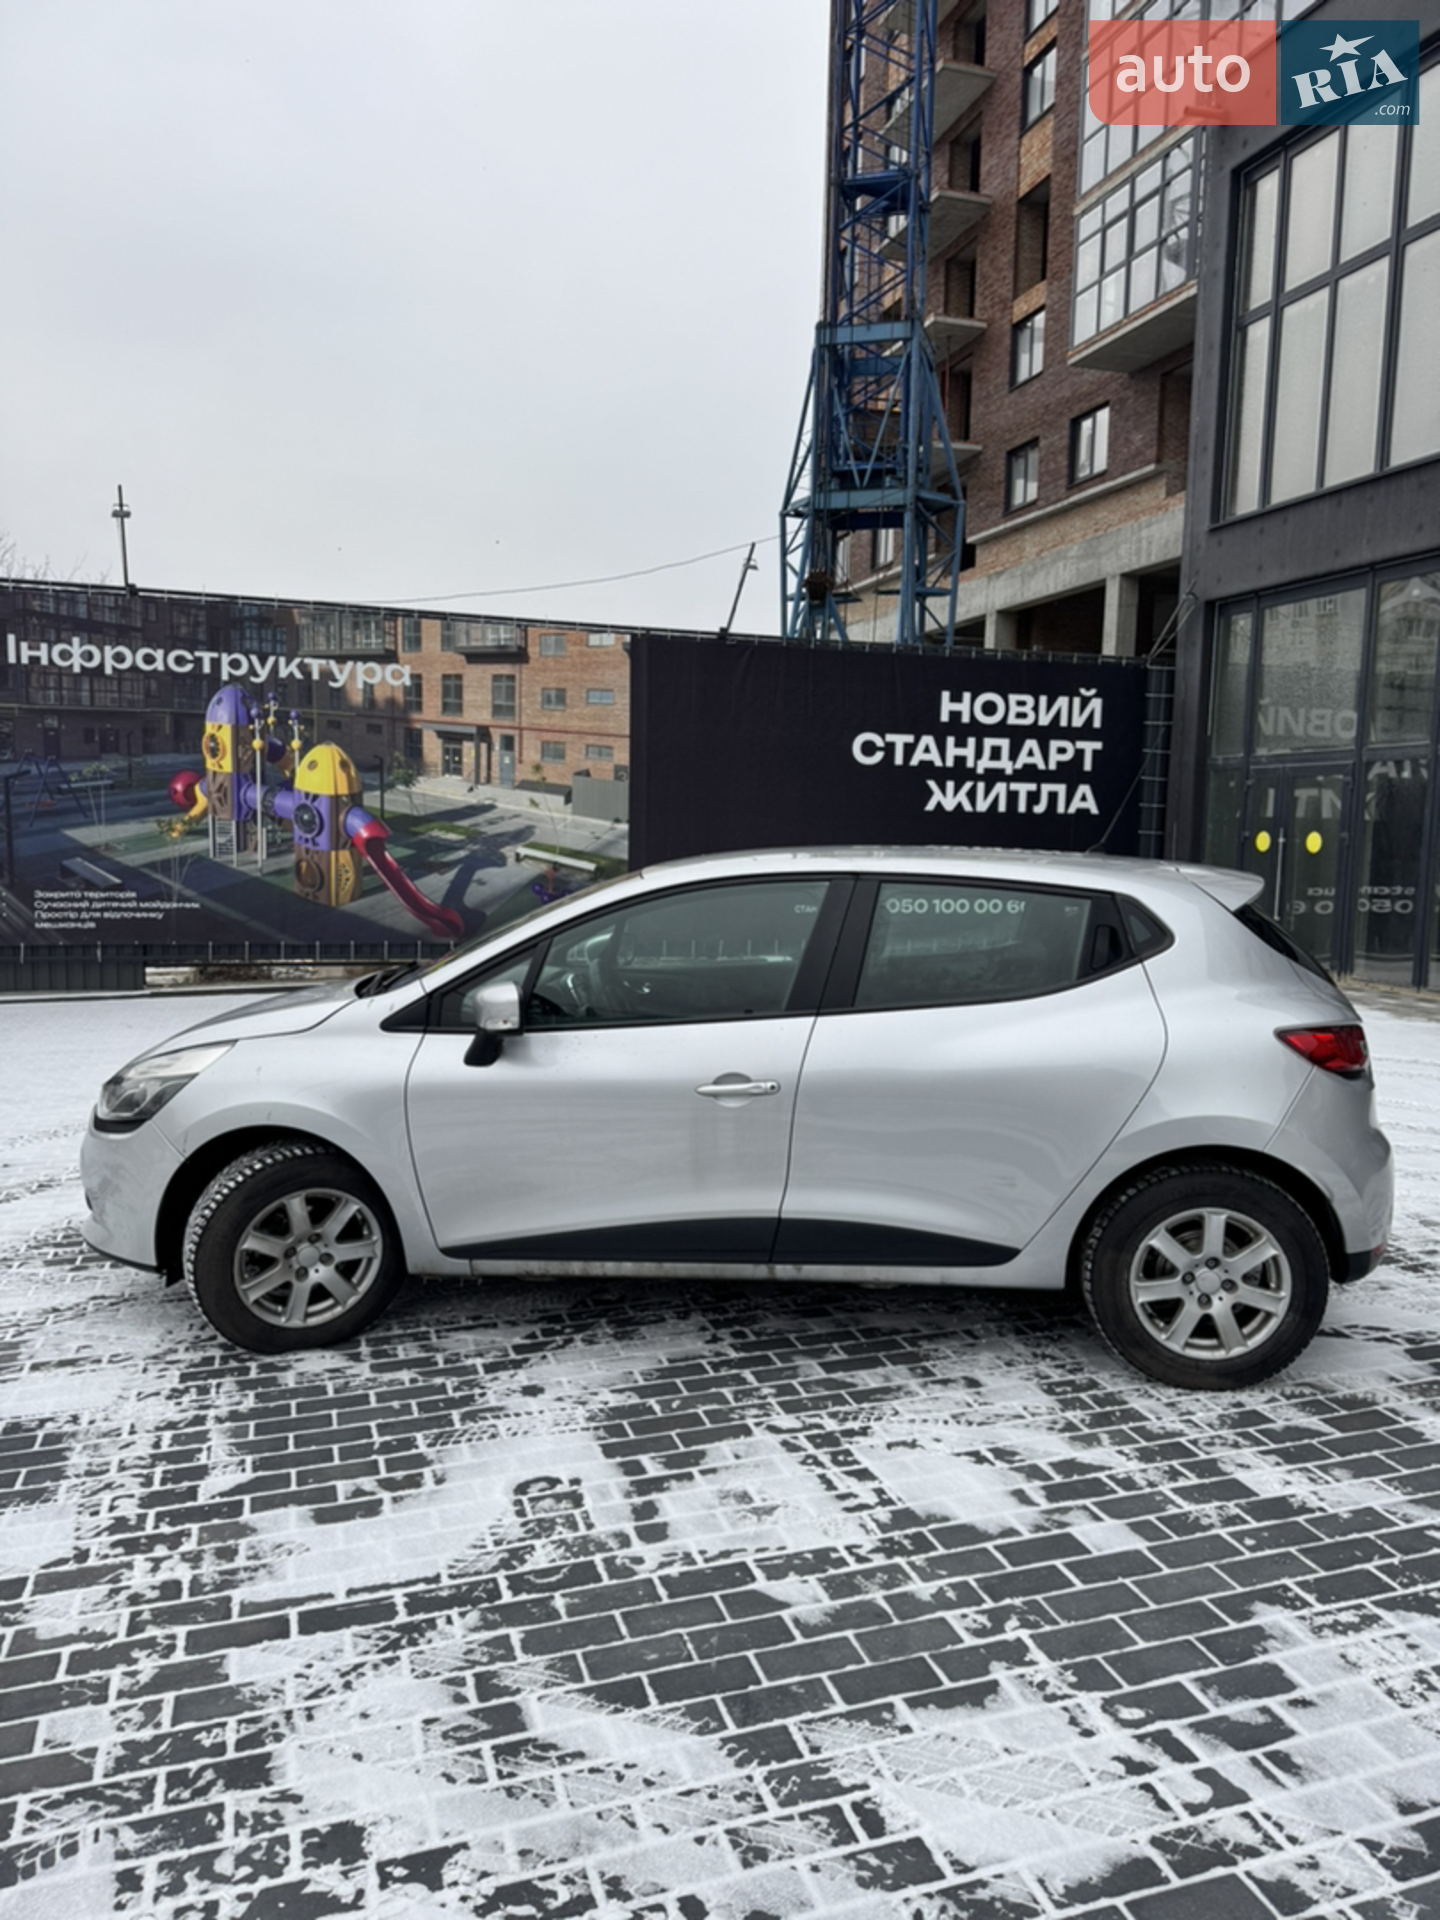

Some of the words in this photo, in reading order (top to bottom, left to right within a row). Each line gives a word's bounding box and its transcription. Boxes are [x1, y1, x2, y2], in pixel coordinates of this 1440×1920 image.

[6, 633, 412, 688] Інфраструктура
[940, 687, 1103, 729] НОВИЙ
[852, 732, 1103, 775] СТАНДАРТ
[924, 779, 1100, 815] ЖИТЛА
[34, 911, 79, 920] Простір
[886, 899, 928, 914] 050
[932, 899, 973, 914] 100
[974, 899, 1003, 914] 00
